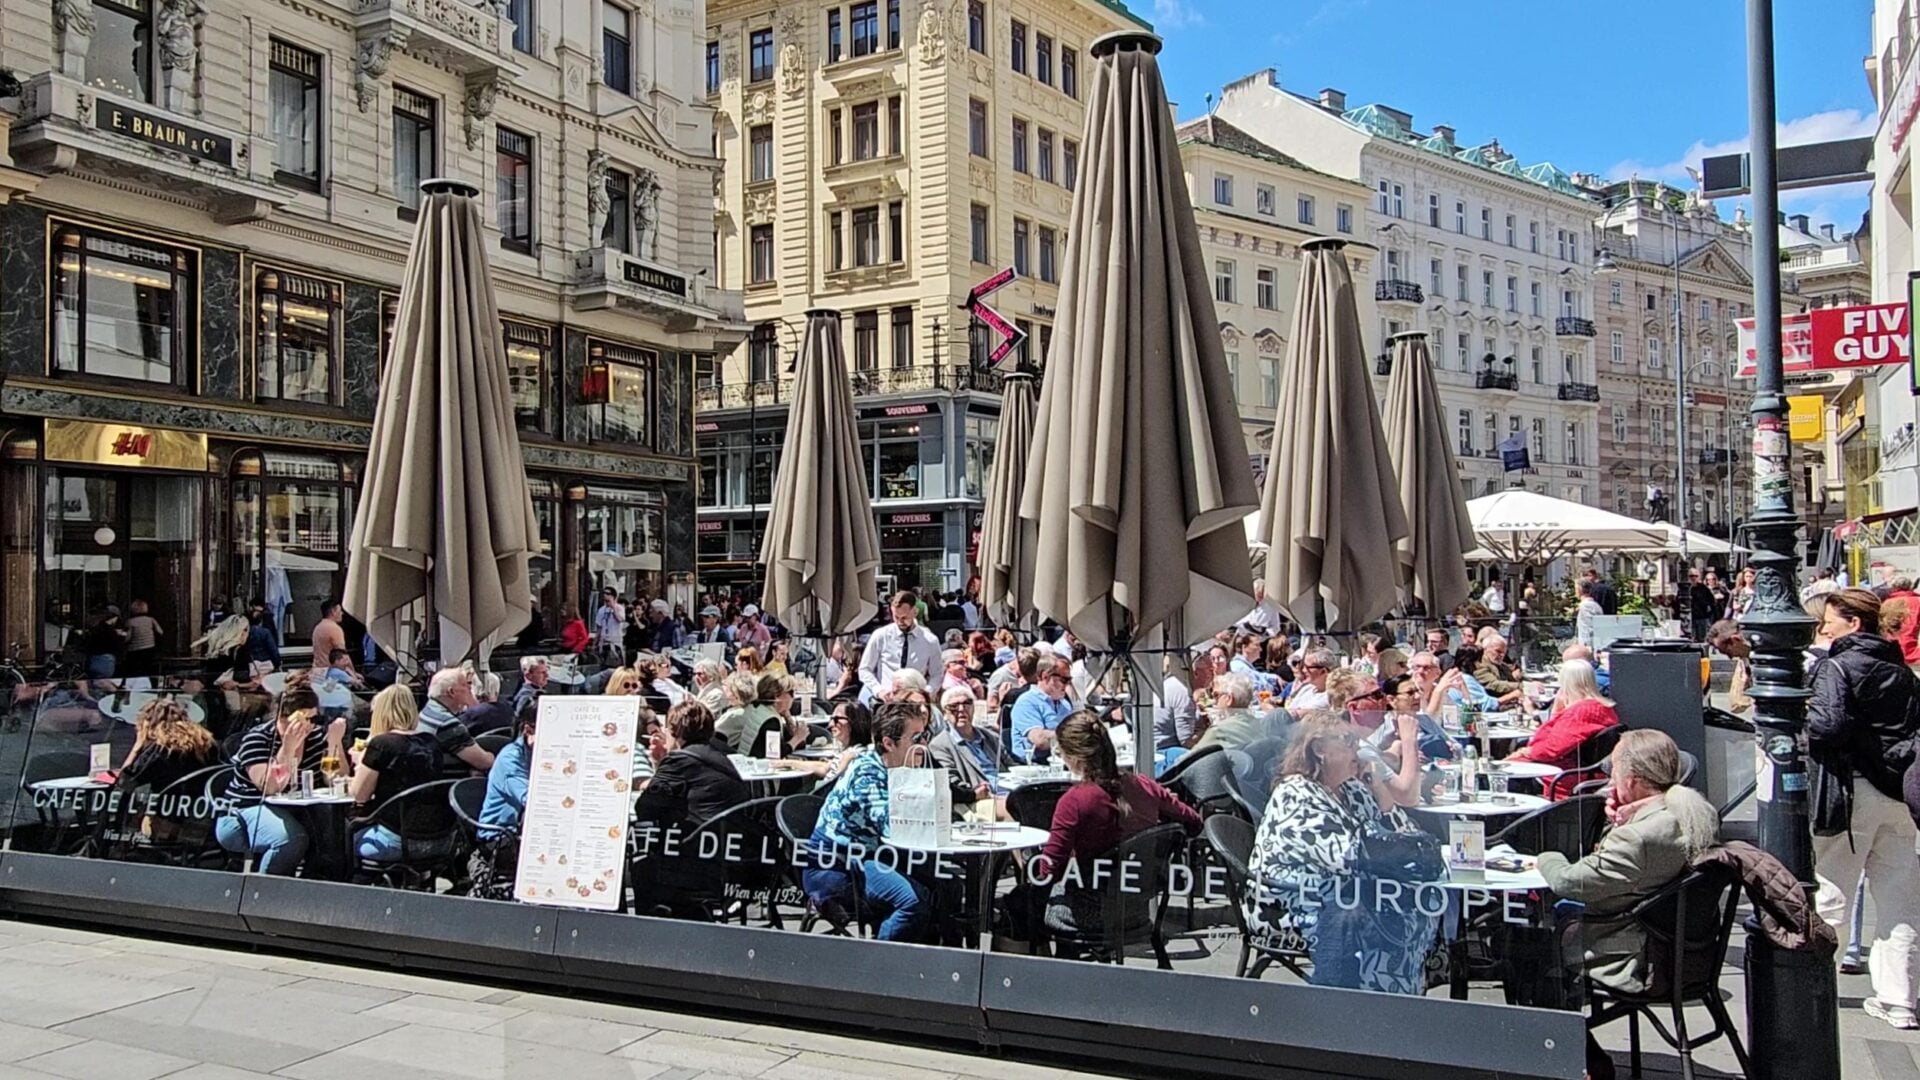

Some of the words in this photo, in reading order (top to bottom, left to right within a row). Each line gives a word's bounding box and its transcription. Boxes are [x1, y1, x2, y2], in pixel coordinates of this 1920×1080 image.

[112, 111, 127, 130] E.
[133, 117, 186, 147] BRAUN
[191, 140, 198, 150] &
[640, 269, 665, 286] BRAUN
[1843, 307, 1906, 335] FIV
[1834, 334, 1909, 362] GUY
[885, 404, 928, 416] SOUVENIRS
[111, 432, 153, 458] H&M
[892, 513, 931, 523] SOUVENIRS
[1498, 521, 1560, 529] GUYS
[92, 789, 122, 813] DE
[128, 793, 241, 819] L'EUROPE
[627, 822, 681, 856] AFÉ
[698, 831, 744, 862] DE
[761, 835, 955, 880] L'EUROPE
[724, 882, 750, 899] Wien
[753, 886, 771, 904] seit
[773, 885, 804, 904] 1952
[1027, 853, 1142, 893] CAFÉ
[1168, 864, 1227, 899] DE
[1255, 868, 1530, 924] LEUROPE
[1279, 933, 1320, 953] 1952
